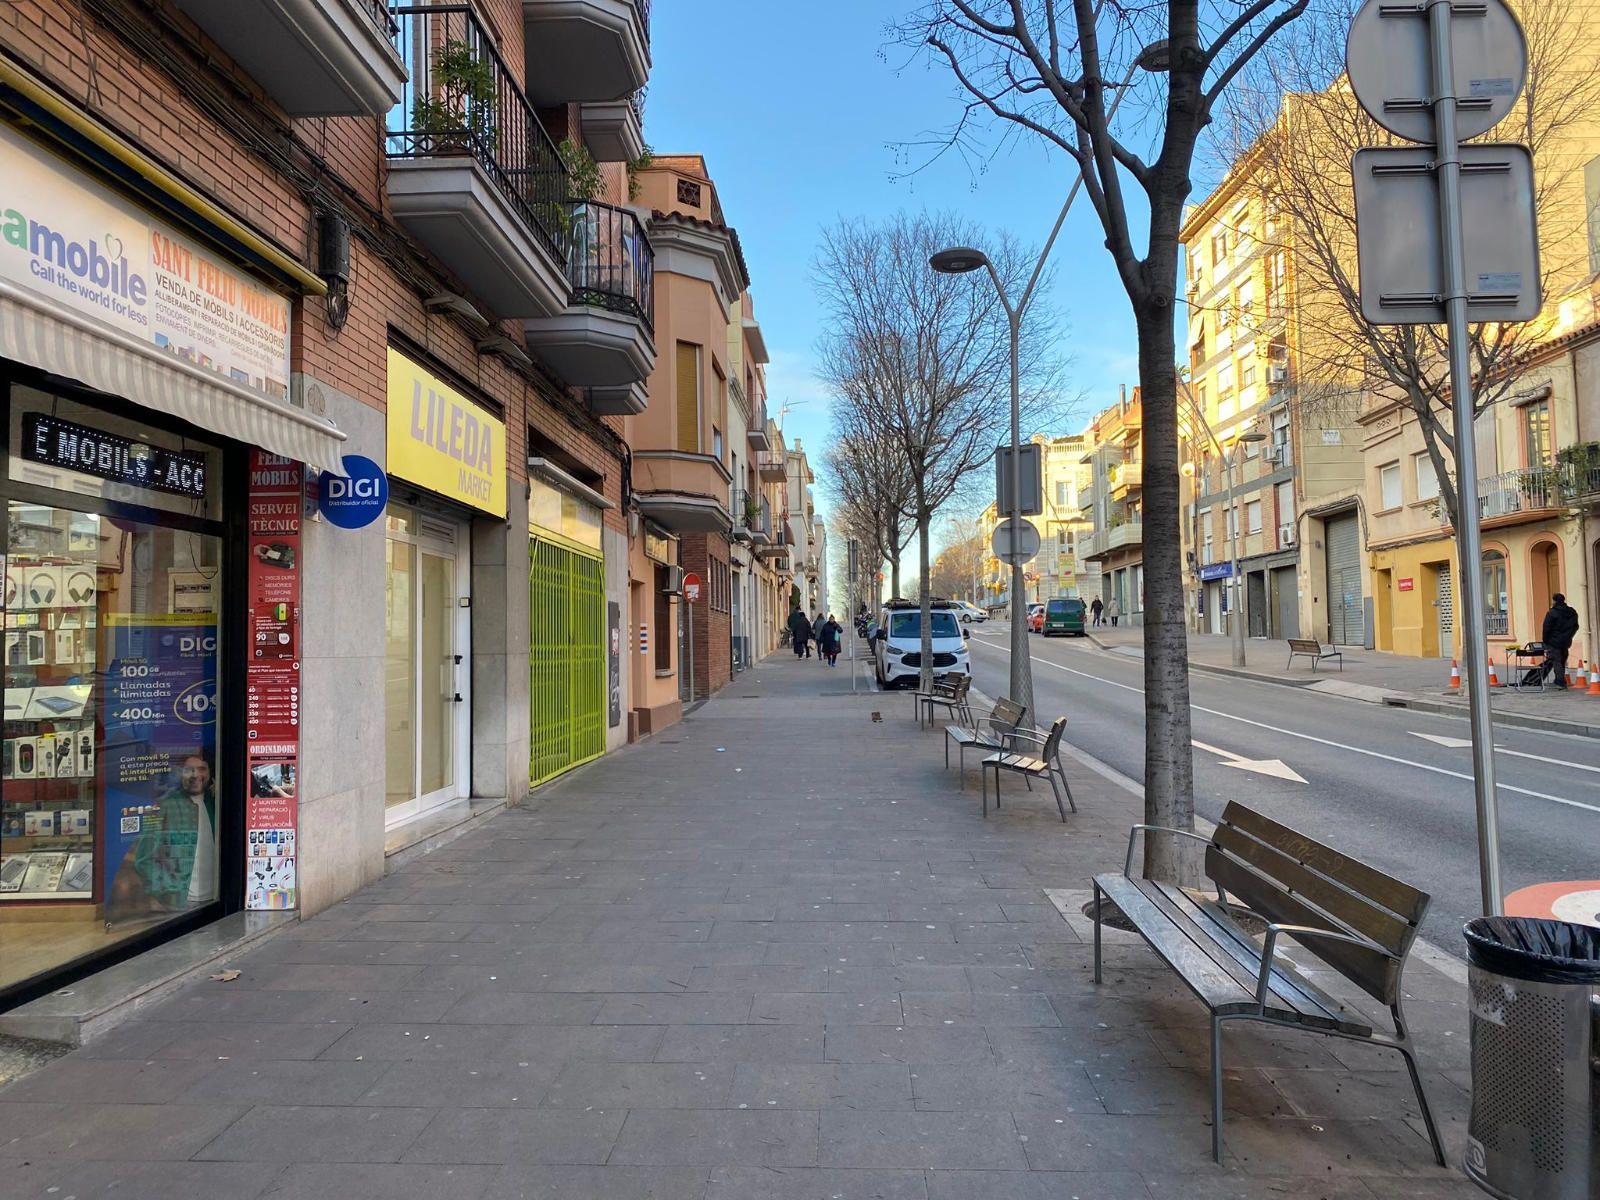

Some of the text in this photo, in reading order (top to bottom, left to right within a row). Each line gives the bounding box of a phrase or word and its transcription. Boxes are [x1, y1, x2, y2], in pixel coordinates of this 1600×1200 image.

[0, 208, 147, 306] amobile
[152, 231, 192, 283] SANT
[197, 257, 237, 307] FELIU
[30, 259, 148, 326] Call the world for less
[155, 289, 198, 316] ALLIBERAMENT
[155, 272, 188, 300] VENDA
[190, 290, 201, 307] DE
[240, 320, 285, 350] ACCESSORIS
[410, 378, 492, 477] LILEDA
[36, 424, 49, 456] E
[57, 431, 148, 478] MOBILS
[251, 467, 298, 487] MÒBILS
[457, 468, 492, 503] MARKET
[328, 478, 380, 498] DIGI
[251, 503, 297, 515] SERVEI
[250, 517, 299, 531] TÈCNIC
[255, 633, 267, 641] 90
[120, 665, 149, 678] 100
[120, 680, 171, 690] Llamadas
[120, 689, 171, 699] ilimitadas
[120, 707, 152, 720] 400
[250, 744, 296, 754] ORDINADORS
[127, 761, 144, 769] este
[145, 760, 169, 768] precio
[129, 766, 172, 775] inteligente
